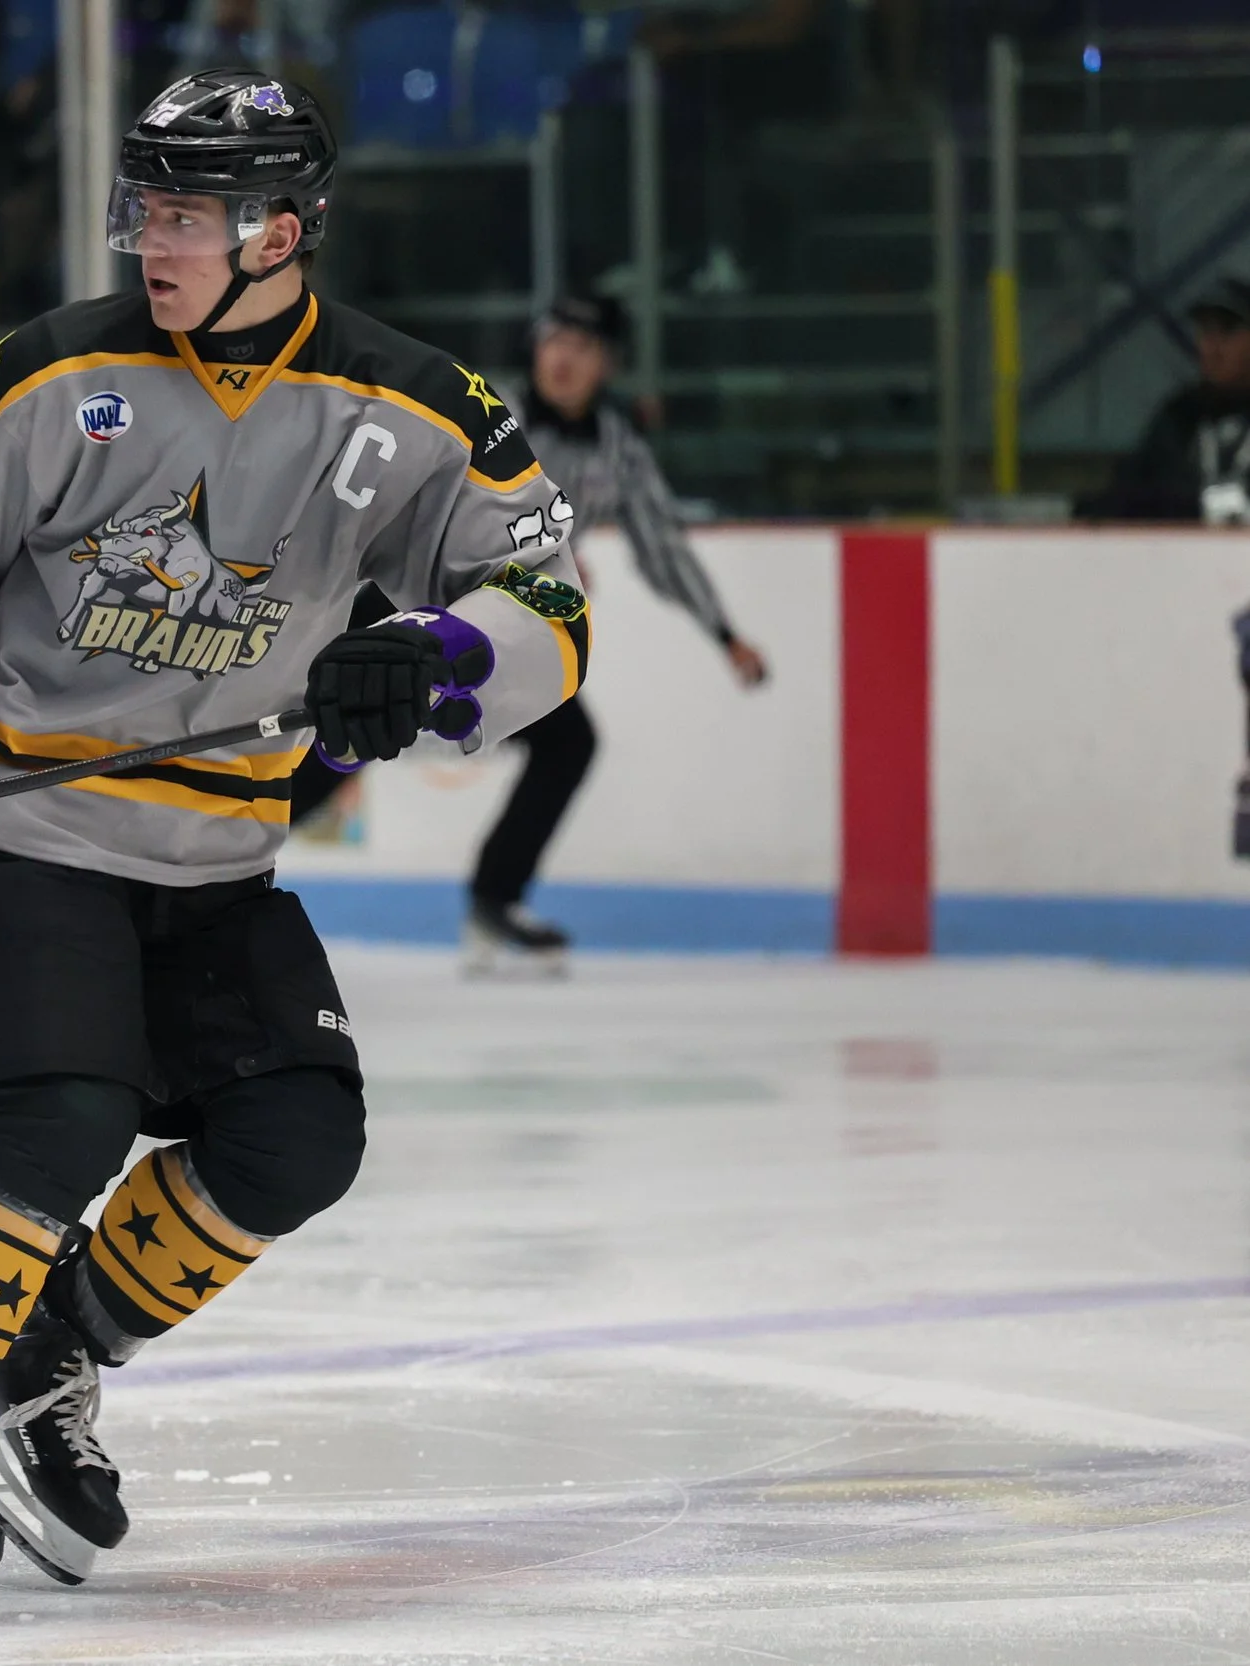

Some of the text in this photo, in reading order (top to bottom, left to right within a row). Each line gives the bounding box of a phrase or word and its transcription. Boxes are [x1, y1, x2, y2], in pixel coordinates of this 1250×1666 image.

[253, 152, 301, 165] BAUER
[494, 415, 519, 443] ARM
[331, 422, 398, 510] C
[255, 599, 291, 620] TAR
[78, 604, 279, 675] BRAHMS
[317, 1009, 352, 1038] BA
